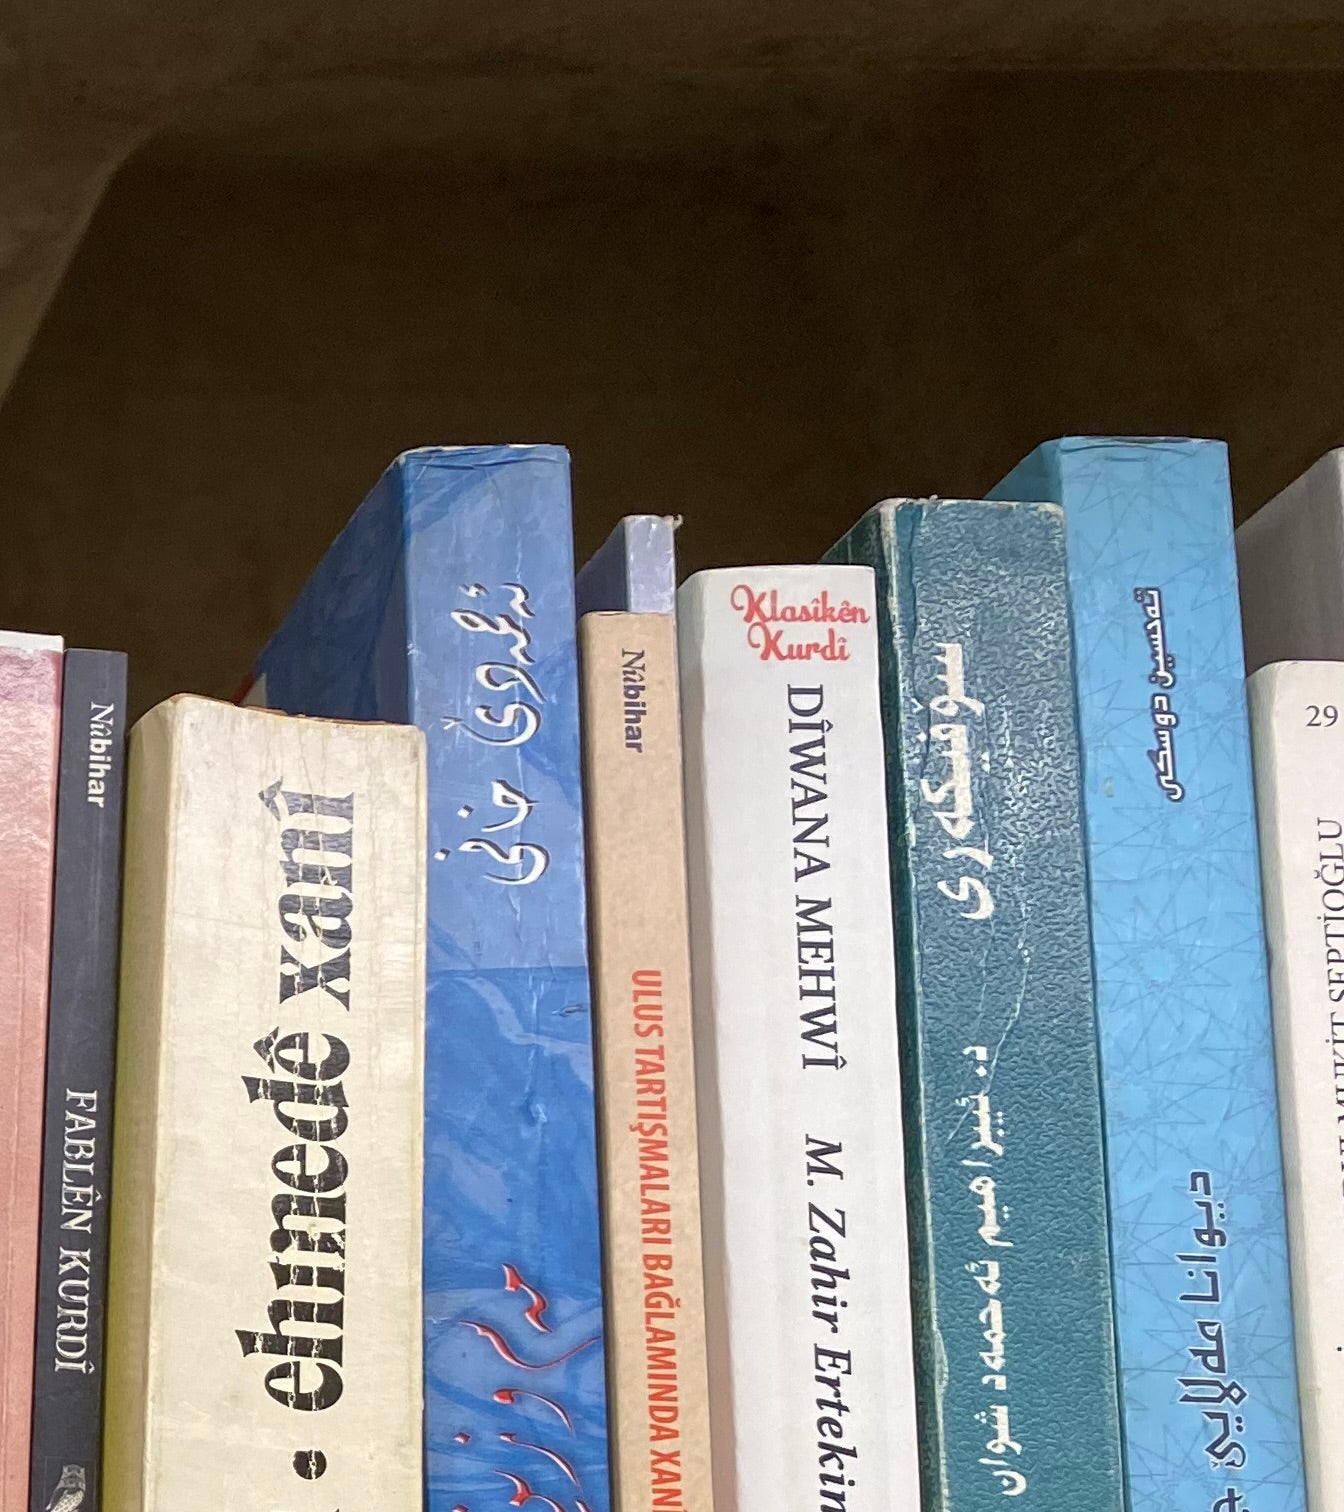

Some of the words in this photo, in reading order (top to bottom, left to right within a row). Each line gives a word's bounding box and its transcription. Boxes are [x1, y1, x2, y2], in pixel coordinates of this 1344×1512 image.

[731, 584, 870, 624] Klasîkên
[748, 622, 850, 662] Kurdî
[787, 684, 834, 883] DÎWANA
[1305, 705, 1338, 727] 29
[258, 776, 354, 1012] xanî
[631, 970, 663, 1038] ULUS
[795, 897, 846, 1070] MEHWÎ
[61, 1087, 101, 1235] FABLÊN
[630, 1045, 671, 1245] TARTIŞMALARI
[805, 1134, 843, 1187] M.
[234, 1026, 350, 1412] ehmedê
[809, 1202, 850, 1335] Zahir
[54, 1247, 92, 1375] KURDÎ
[643, 1254, 681, 1442] BAĞLAMINDA
